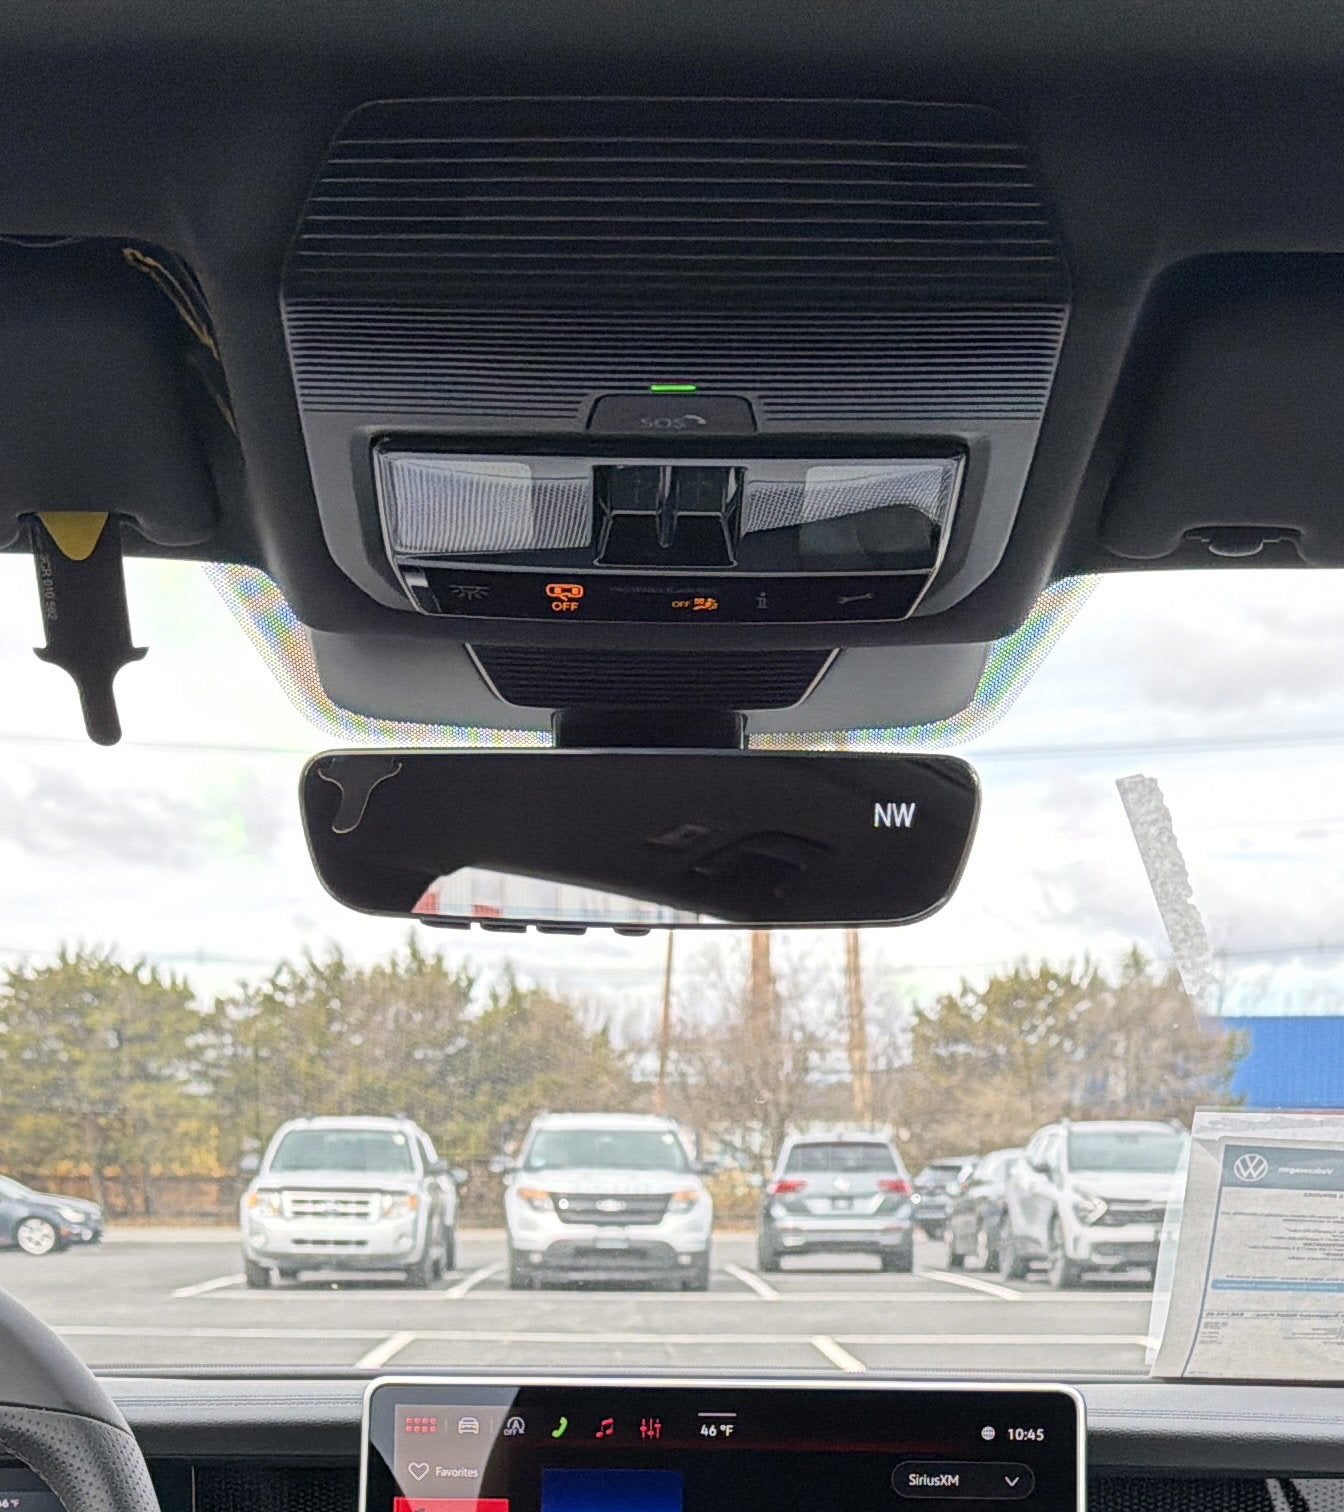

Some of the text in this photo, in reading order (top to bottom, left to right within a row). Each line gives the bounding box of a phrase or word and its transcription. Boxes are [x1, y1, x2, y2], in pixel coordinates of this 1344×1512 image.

[551, 601, 580, 613] OFF
[671, 600, 691, 608] OFF
[874, 802, 916, 828] NW
[699, 1423, 718, 1437] 46
[1007, 1427, 1045, 1442] 10:45
[435, 1465, 479, 1478] Favorites
[908, 1474, 960, 1487] SiriusXM
